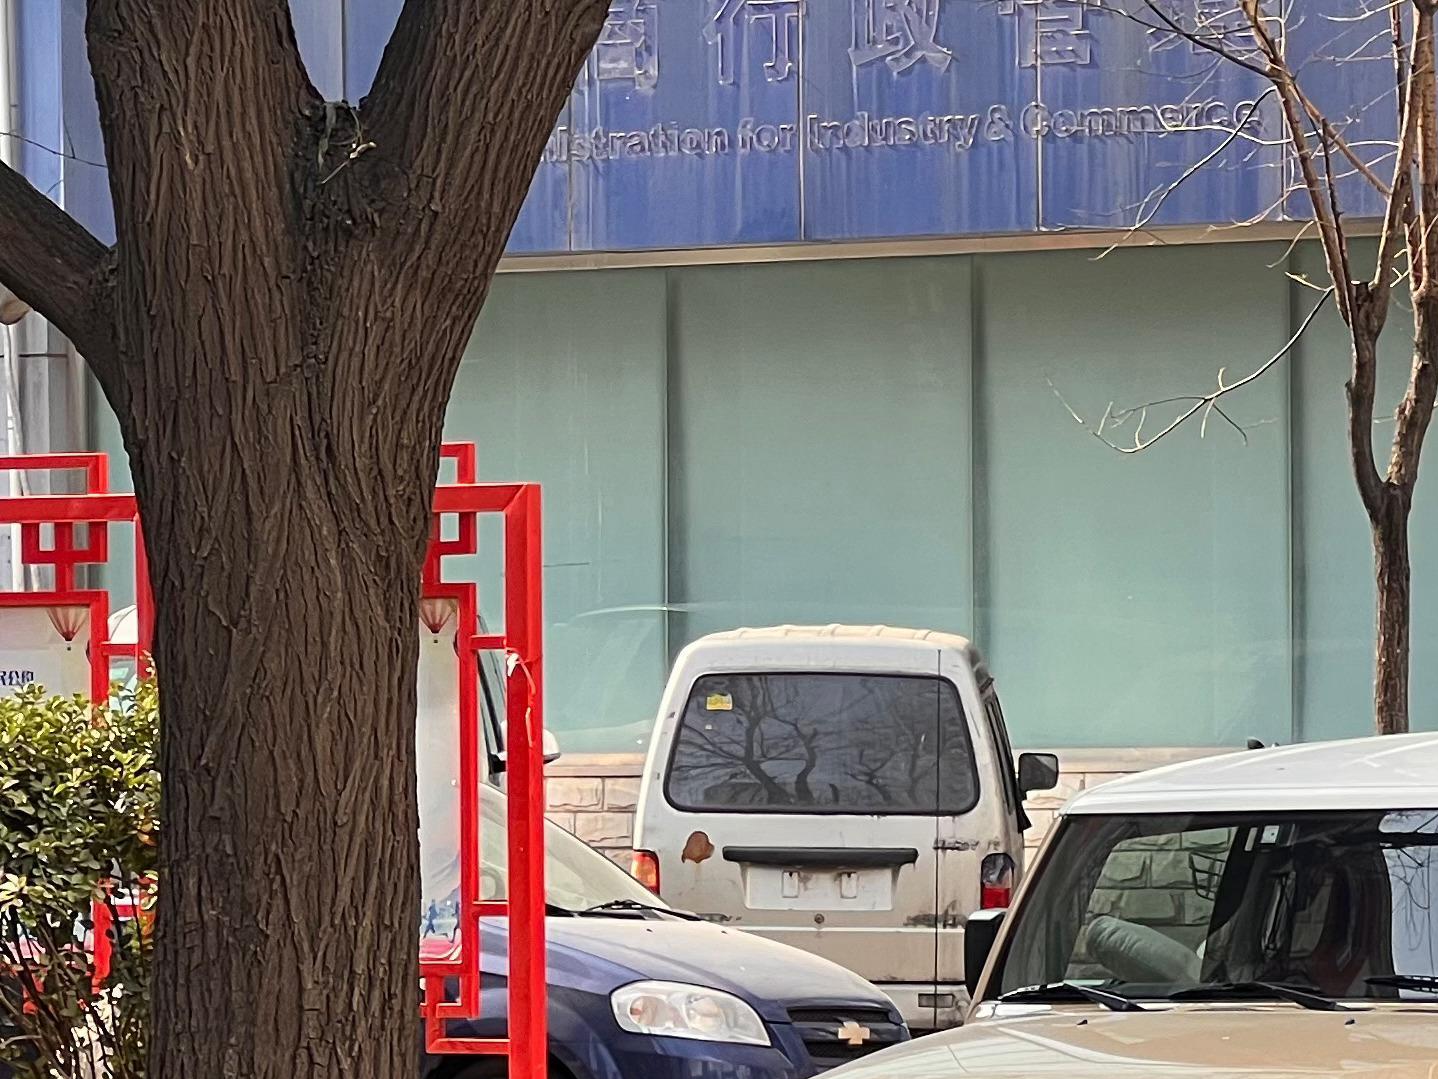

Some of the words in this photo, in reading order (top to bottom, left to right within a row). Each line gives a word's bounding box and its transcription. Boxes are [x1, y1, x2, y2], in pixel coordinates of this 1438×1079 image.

[737, 116, 798, 152] for
[806, 110, 978, 152] Industry
[984, 103, 1014, 142] &
[1020, 101, 1263, 138] Commerce
